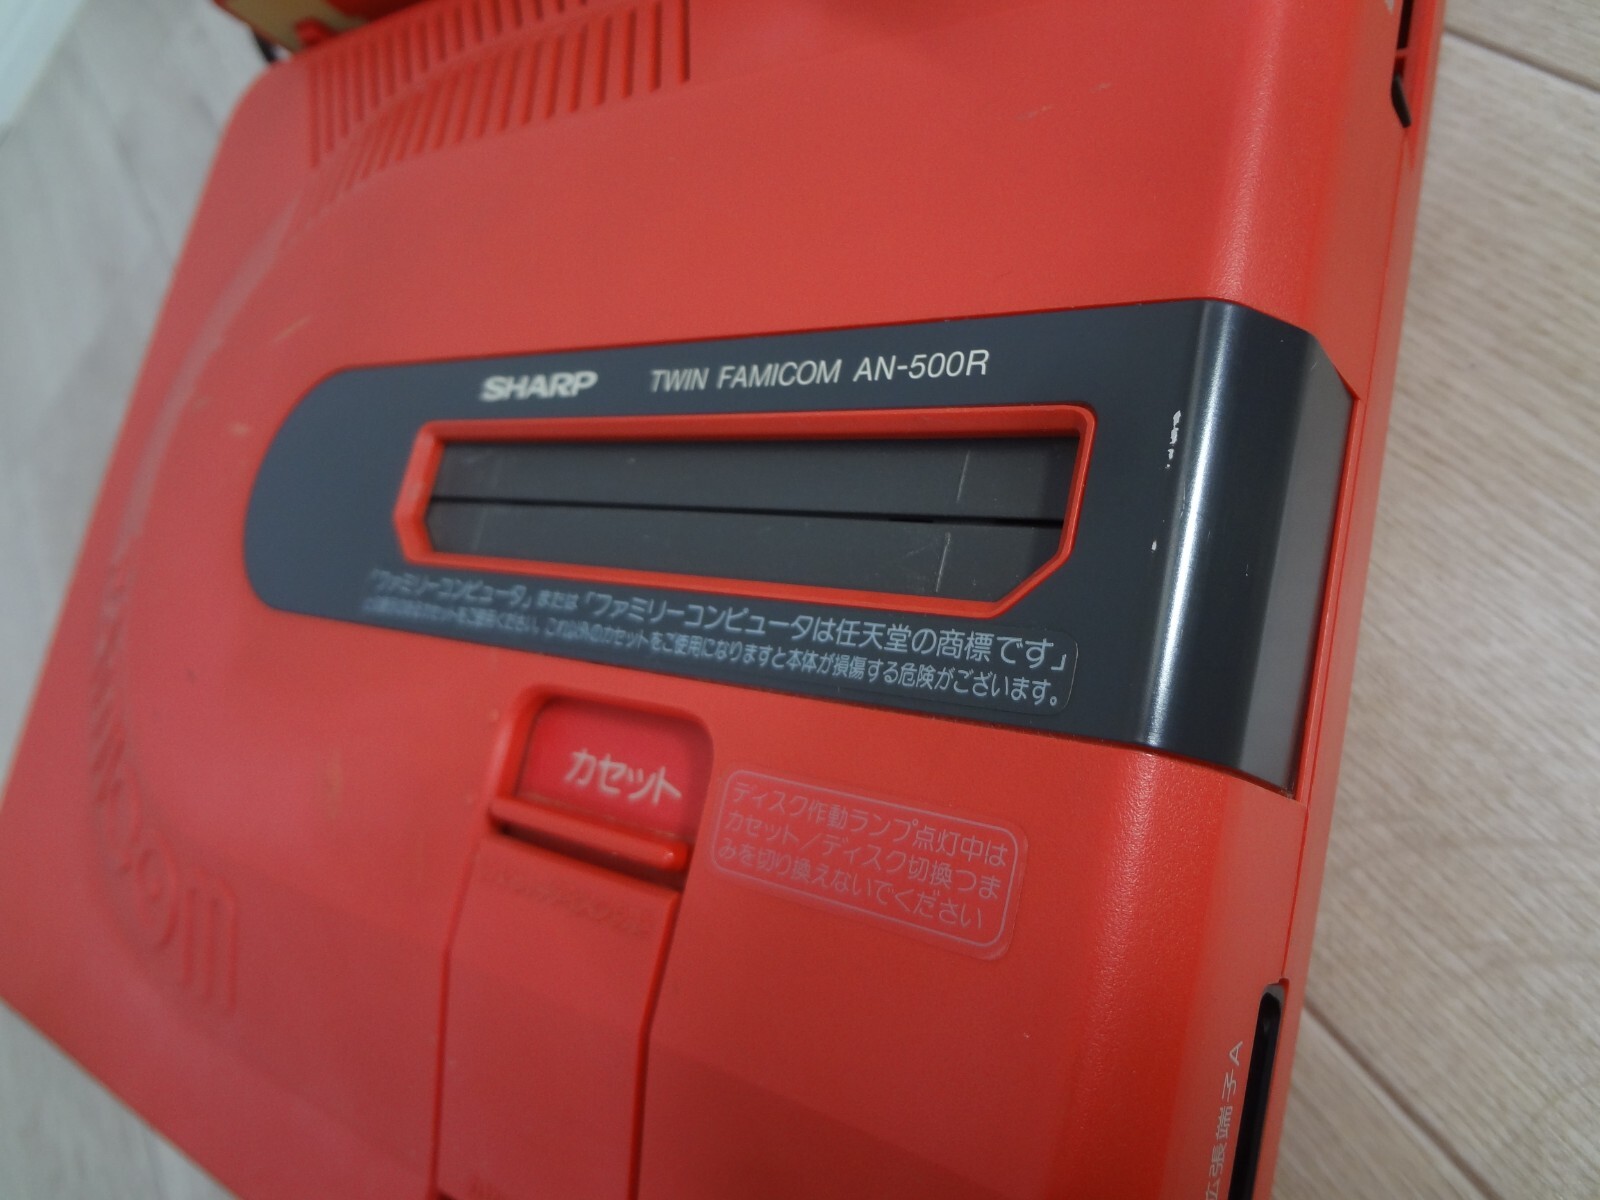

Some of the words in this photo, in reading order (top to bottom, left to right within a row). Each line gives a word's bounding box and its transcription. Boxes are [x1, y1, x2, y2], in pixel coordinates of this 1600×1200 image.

[480, 370, 598, 401] SHARP
[650, 368, 709, 393] TWIN
[716, 358, 842, 390] FAMICOM
[853, 349, 990, 382] AN-500R
[564, 748, 682, 805] カセット
[732, 781, 1009, 867] ディスク作動ランプ点灯中は
[719, 837, 983, 929] みを切り換えないでください
